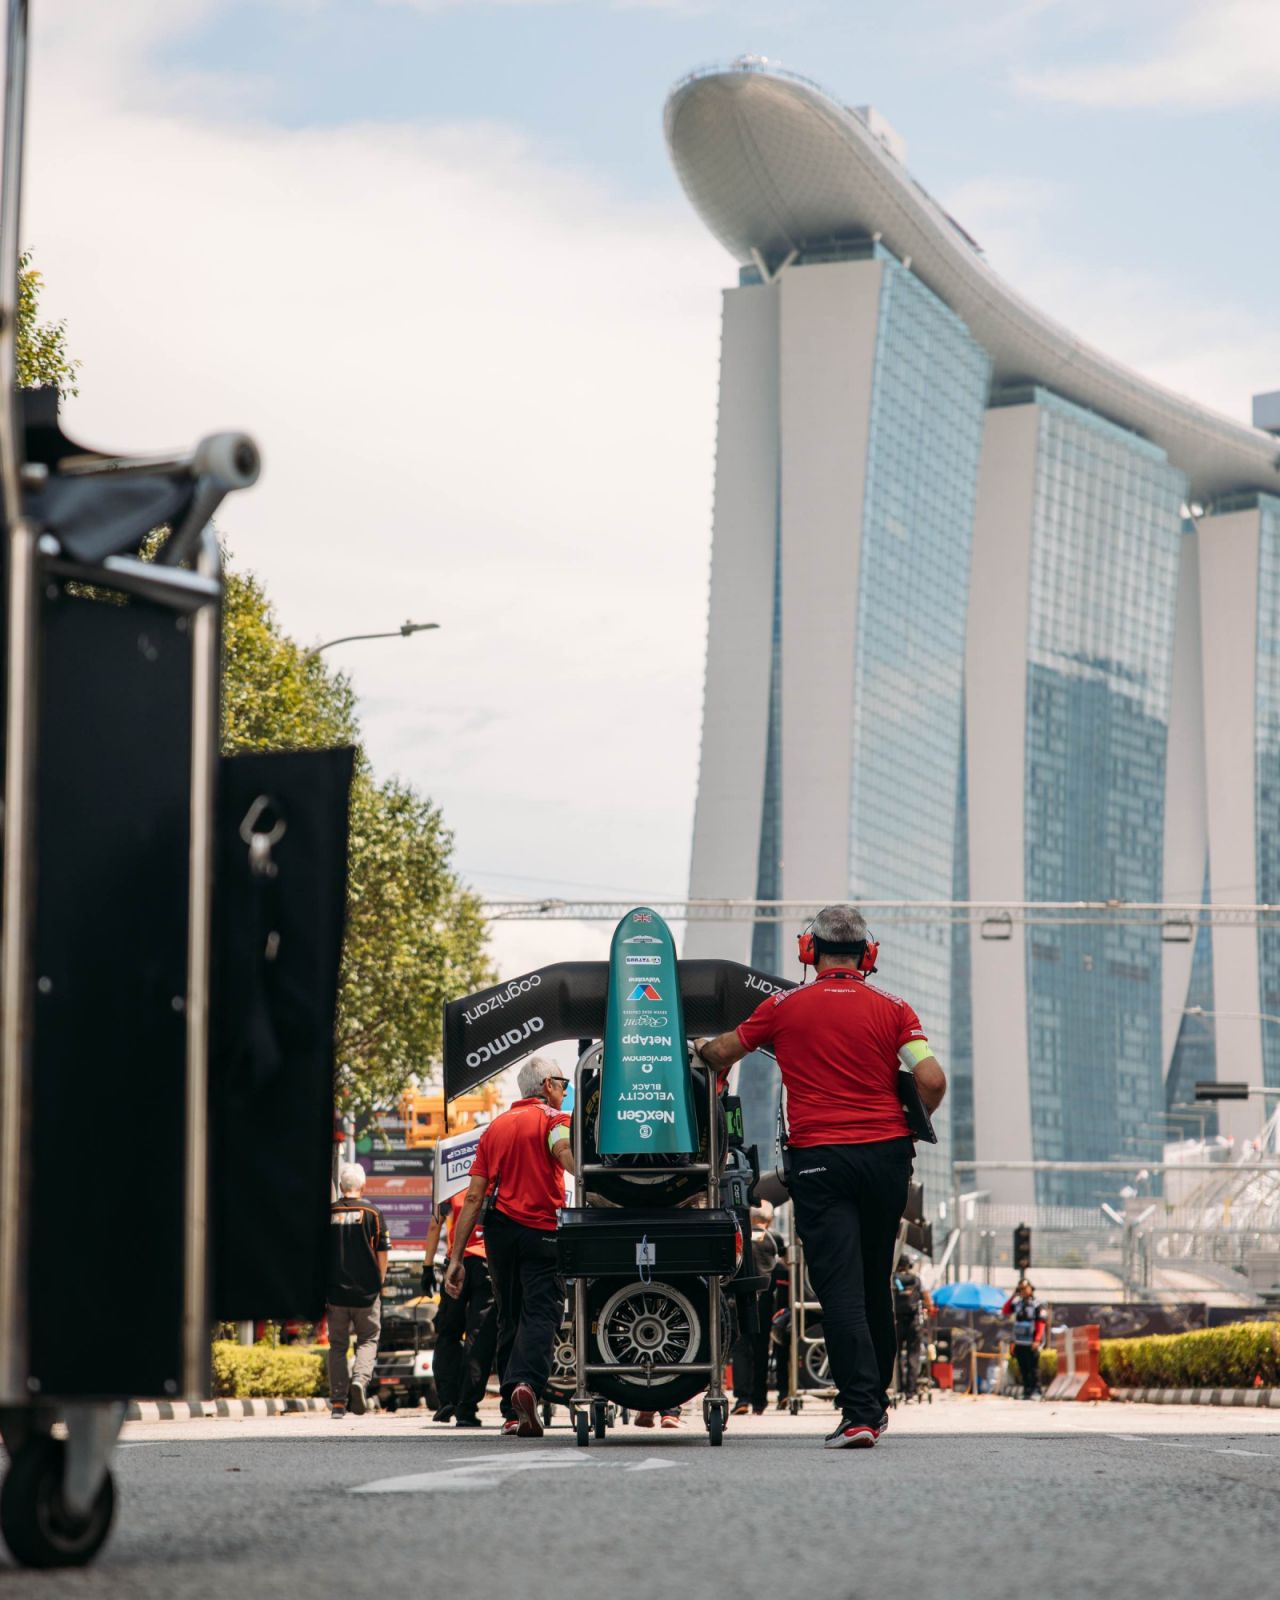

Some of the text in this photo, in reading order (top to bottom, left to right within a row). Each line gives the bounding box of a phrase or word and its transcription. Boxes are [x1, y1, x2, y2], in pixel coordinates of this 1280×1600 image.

[461, 974, 542, 1025] cognizant
[465, 1016, 545, 1068] aramco
[622, 1034, 672, 1047] NetApp
[622, 1055, 673, 1063] servicenow
[618, 1092, 675, 1101] VELOCITY
[617, 1110, 675, 1124] NexGen
[452, 1160, 472, 1173] OU!
